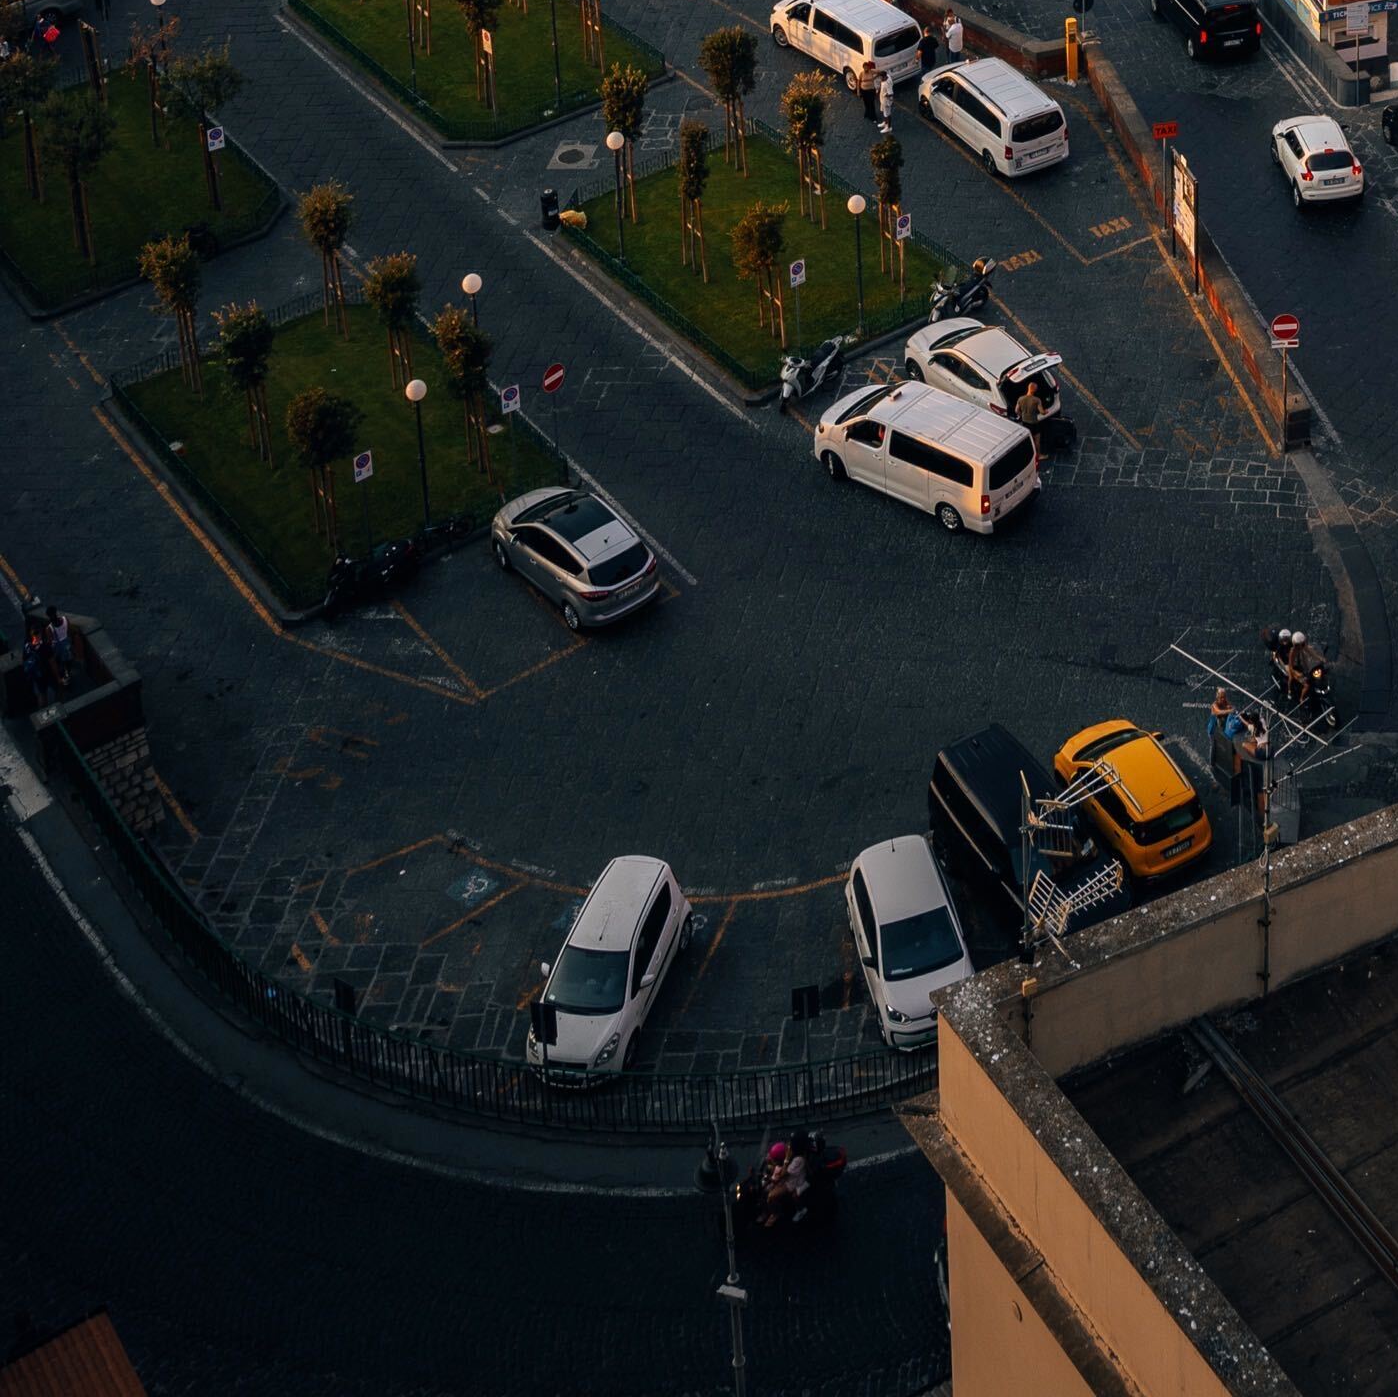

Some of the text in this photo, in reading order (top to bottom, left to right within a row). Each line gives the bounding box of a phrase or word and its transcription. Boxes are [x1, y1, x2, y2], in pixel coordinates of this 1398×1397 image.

[1155, 127, 1177, 137] TAXI
[1088, 216, 1133, 238] TAXI
[998, 249, 1043, 272] TAXI
